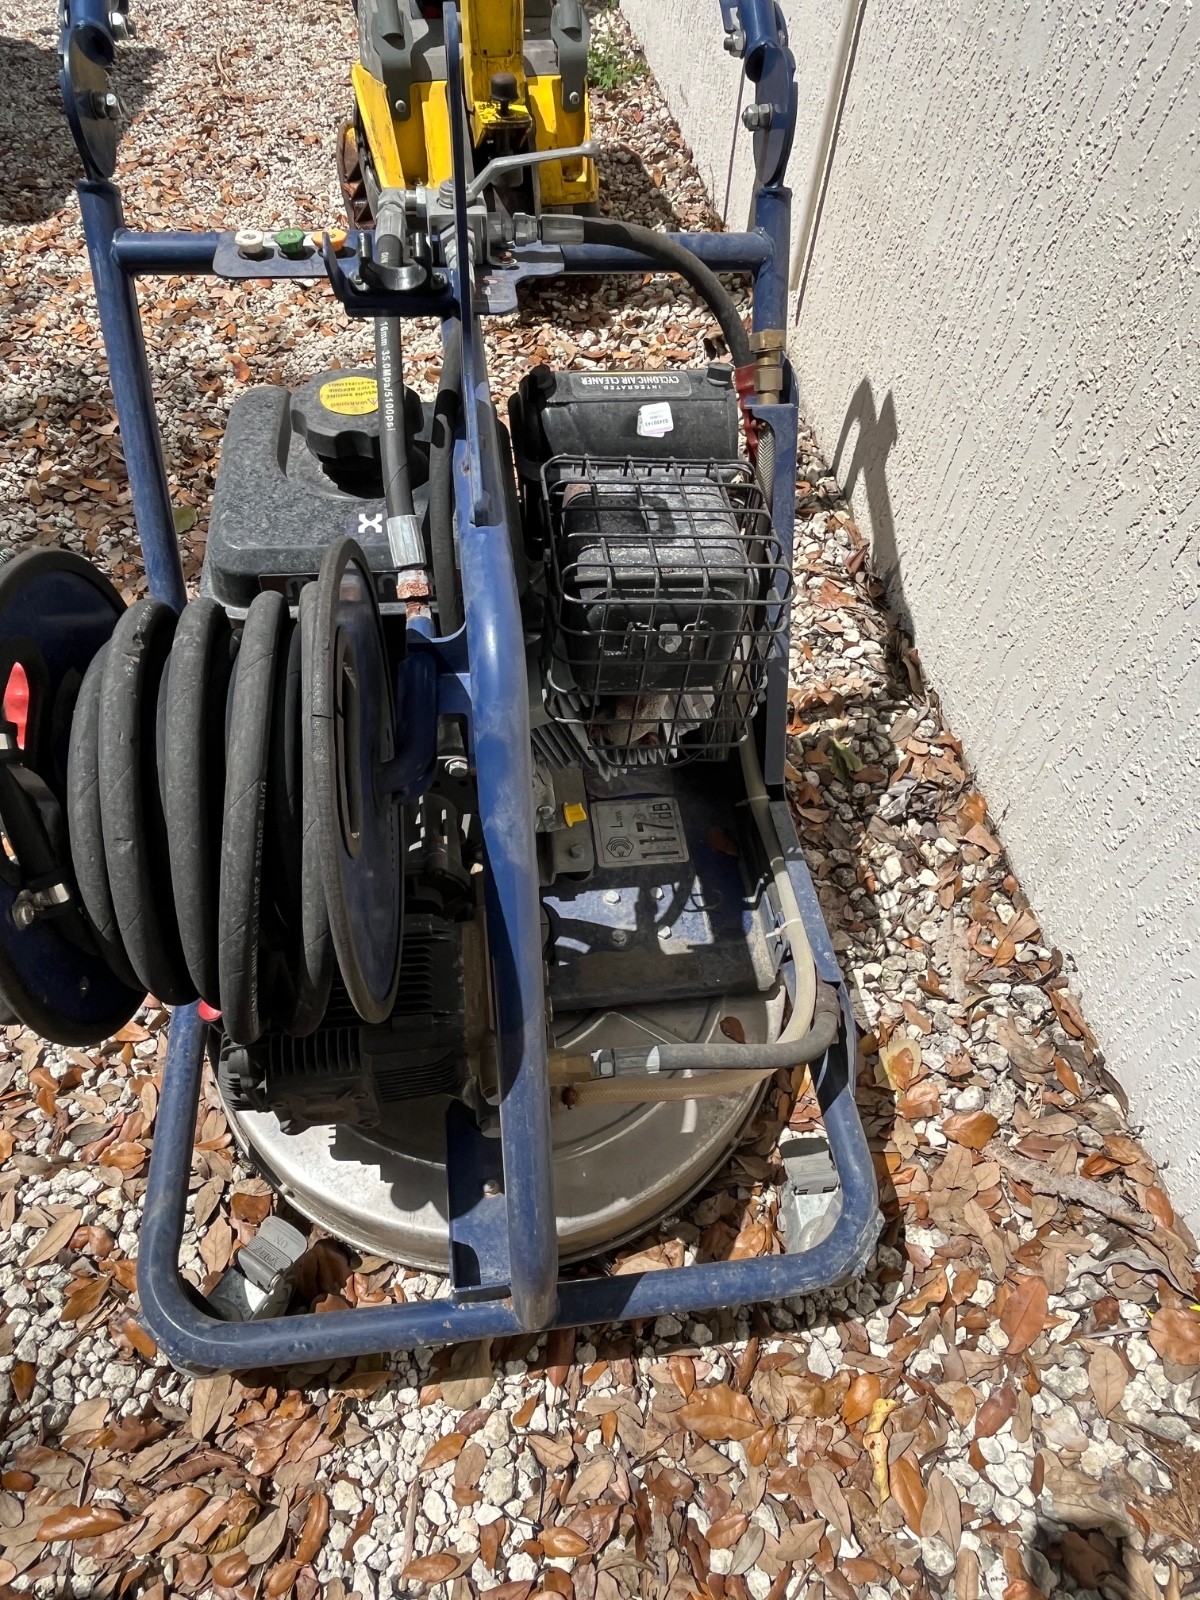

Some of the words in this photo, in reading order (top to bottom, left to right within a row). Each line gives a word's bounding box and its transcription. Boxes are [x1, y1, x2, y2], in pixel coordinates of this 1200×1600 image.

[581, 376, 620, 385] CLEANER
[621, 376, 637, 384] AIR
[639, 376, 680, 385] CYCLONIC
[649, 803, 672, 819] dB
[636, 822, 680, 859] 117
